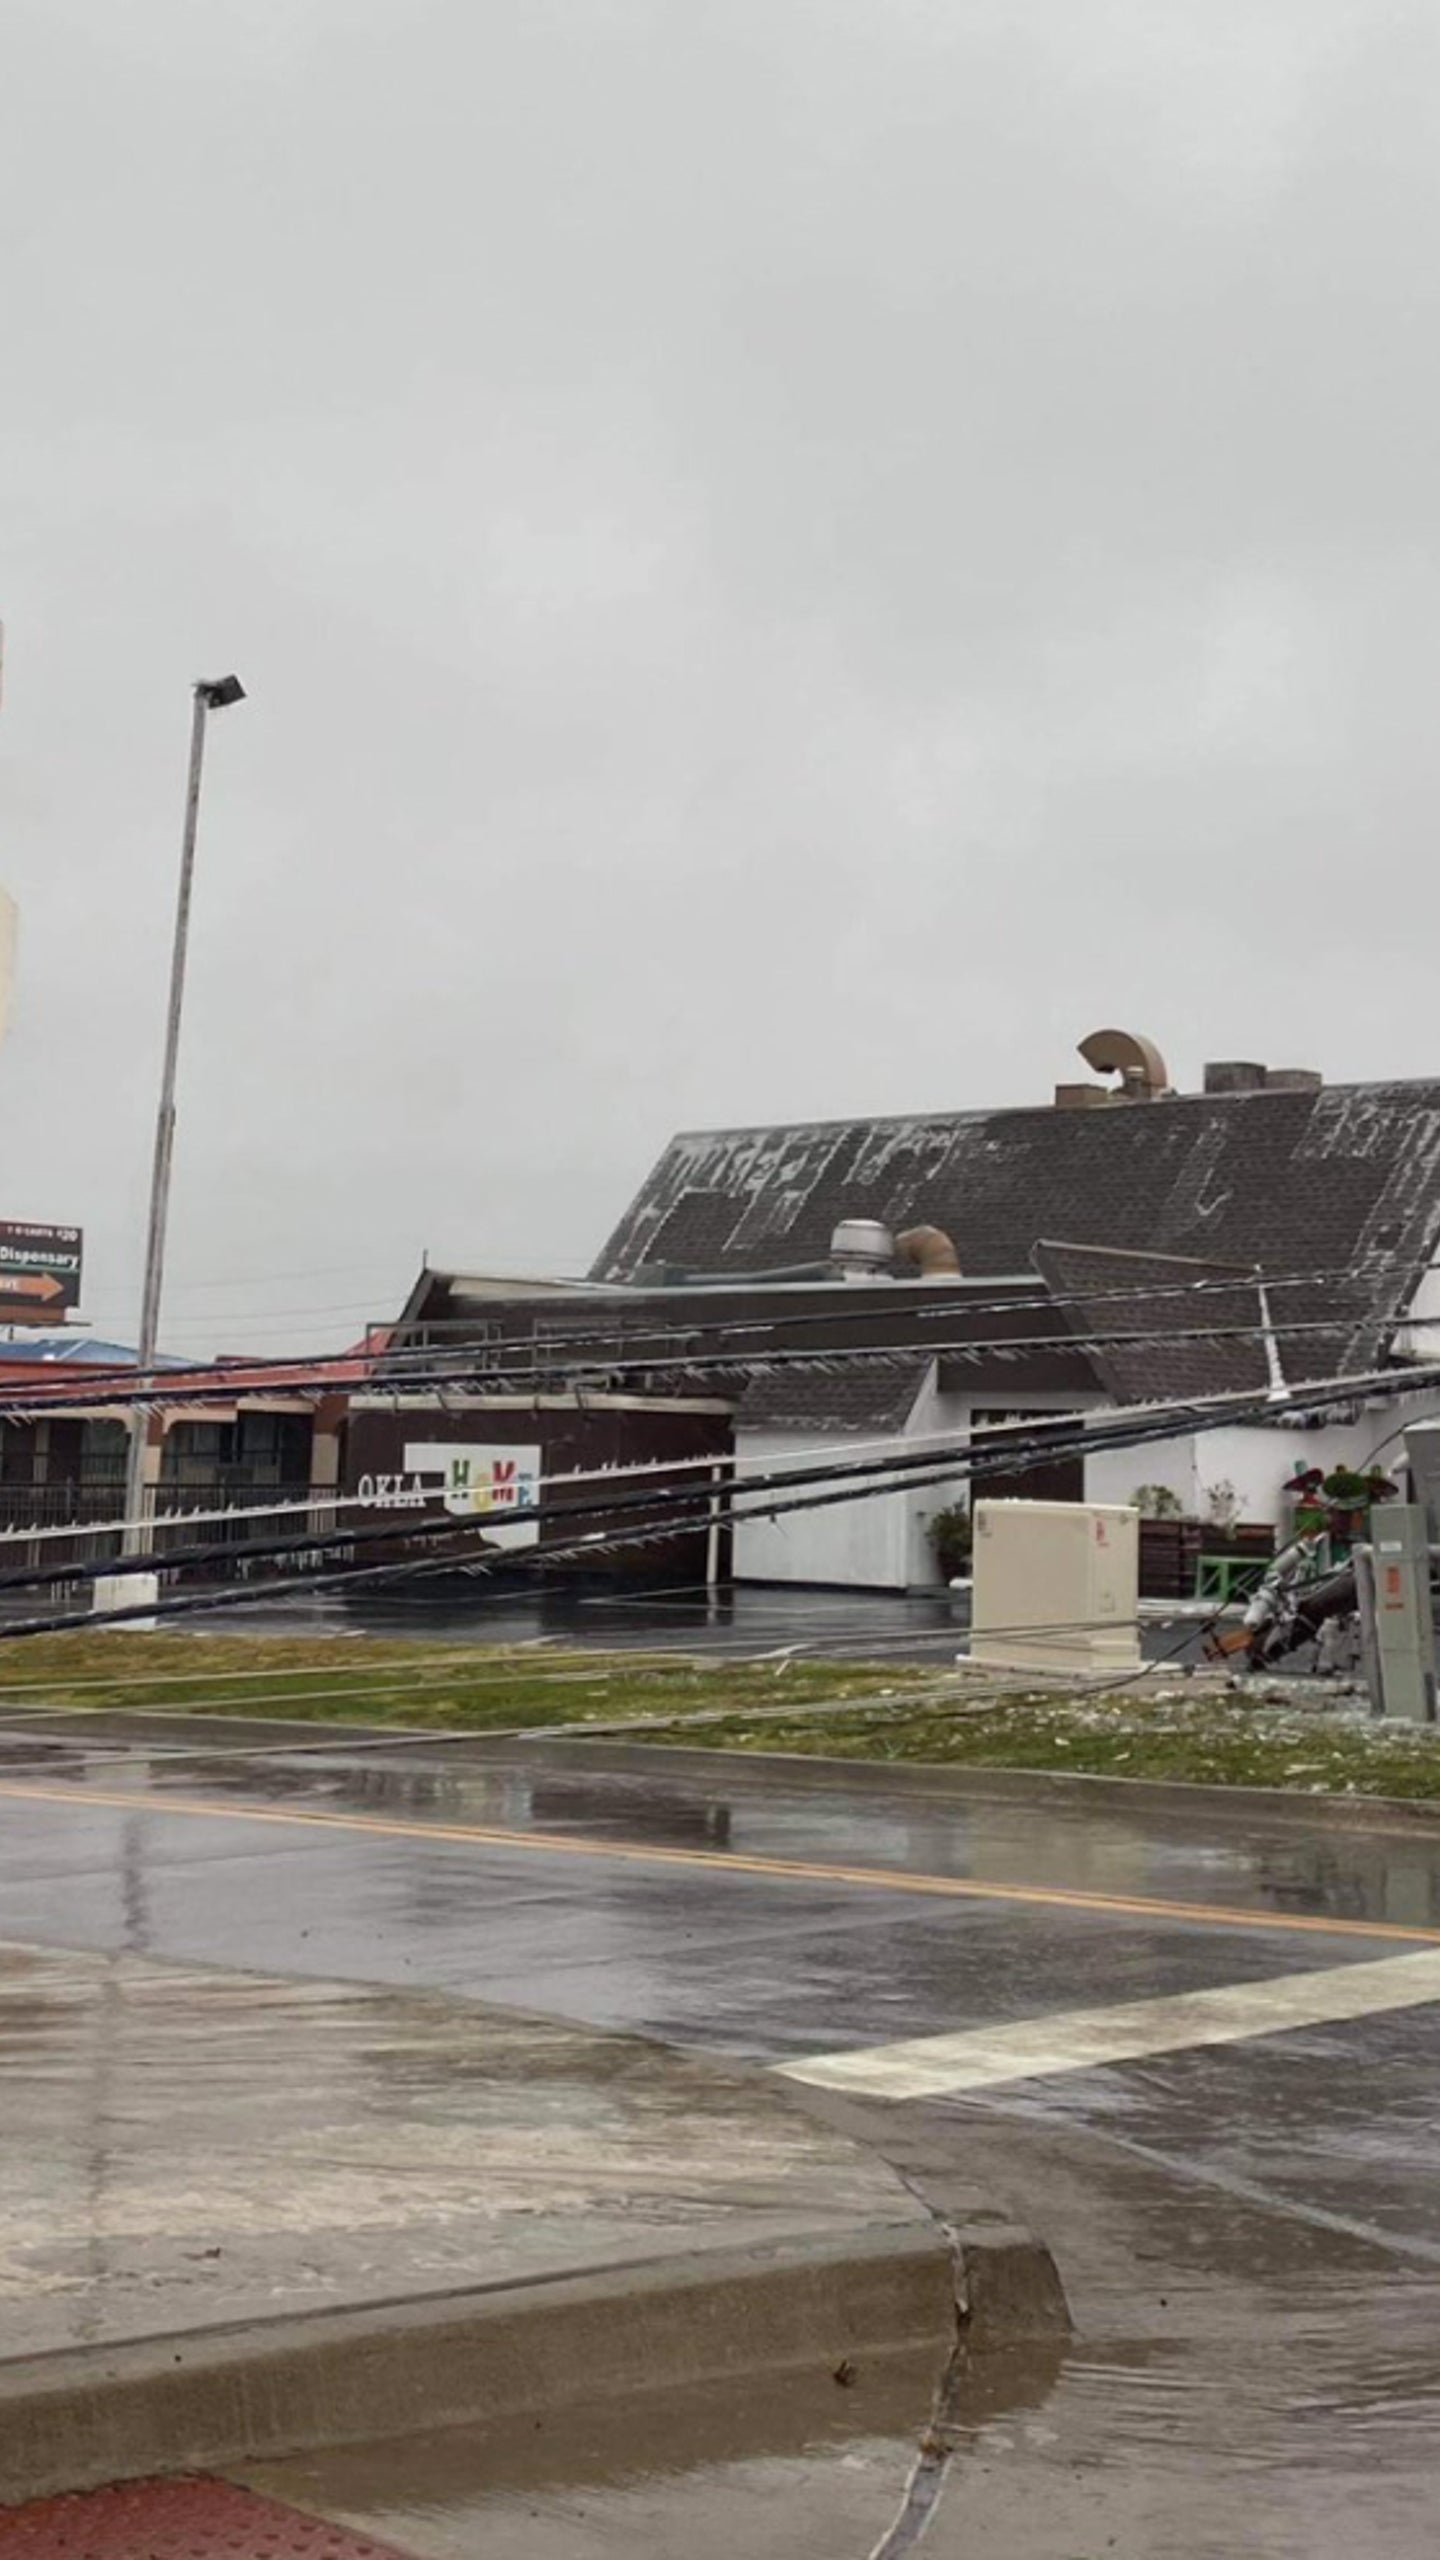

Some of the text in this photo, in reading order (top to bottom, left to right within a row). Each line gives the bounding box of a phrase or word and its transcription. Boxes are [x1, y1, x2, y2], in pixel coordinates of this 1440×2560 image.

[0, 1246, 79, 1269] Dispensary
[358, 1459, 532, 1511] OKLA HOME
